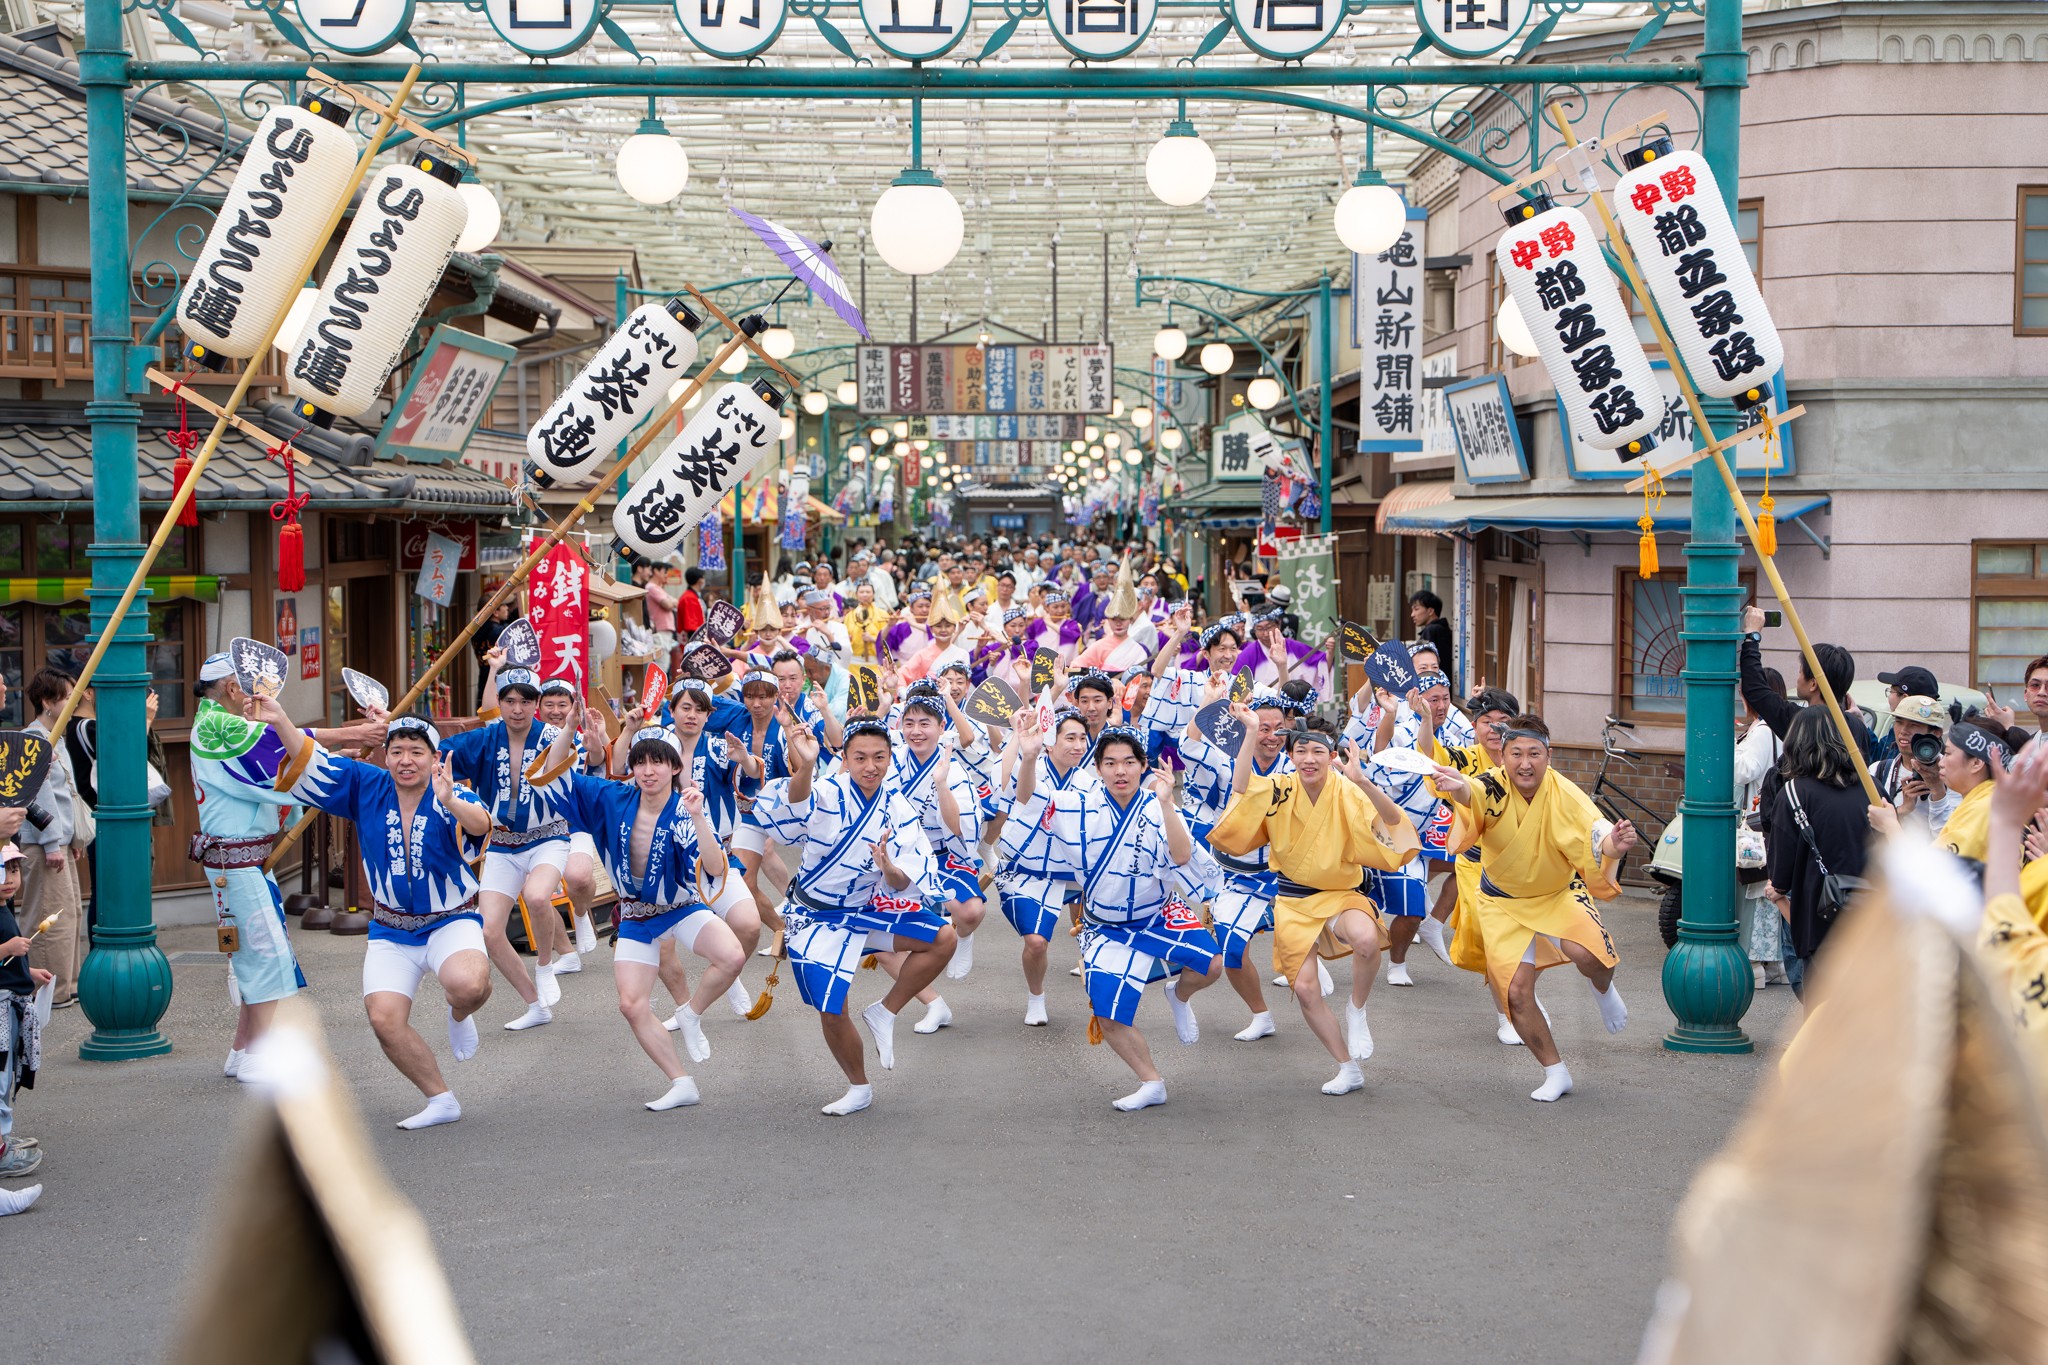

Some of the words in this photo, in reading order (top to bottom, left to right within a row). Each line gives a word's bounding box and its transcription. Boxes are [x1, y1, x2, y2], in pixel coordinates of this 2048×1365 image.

[1630, 166, 1698, 215] 中野
[186, 118, 314, 338] ひょっとこ連
[1511, 221, 1576, 270] 中野
[295, 177, 423, 396] ひょっとこ連
[1654, 204, 1765, 382] 都立家政
[628, 314, 680, 370] むさし
[1535, 260, 1644, 436] 都立家政
[538, 348, 650, 469] 葵連
[718, 394, 768, 448] むさし
[625, 428, 738, 544] 葵連
[430, 549, 445, 600] ラムネ
[239, 651, 282, 684] 葵連
[242, 641, 265, 656] むさし
[386, 808, 407, 876] あおい連
[410, 814, 429, 881] 阿波おどり
[649, 826, 670, 887] 阿波おどり
